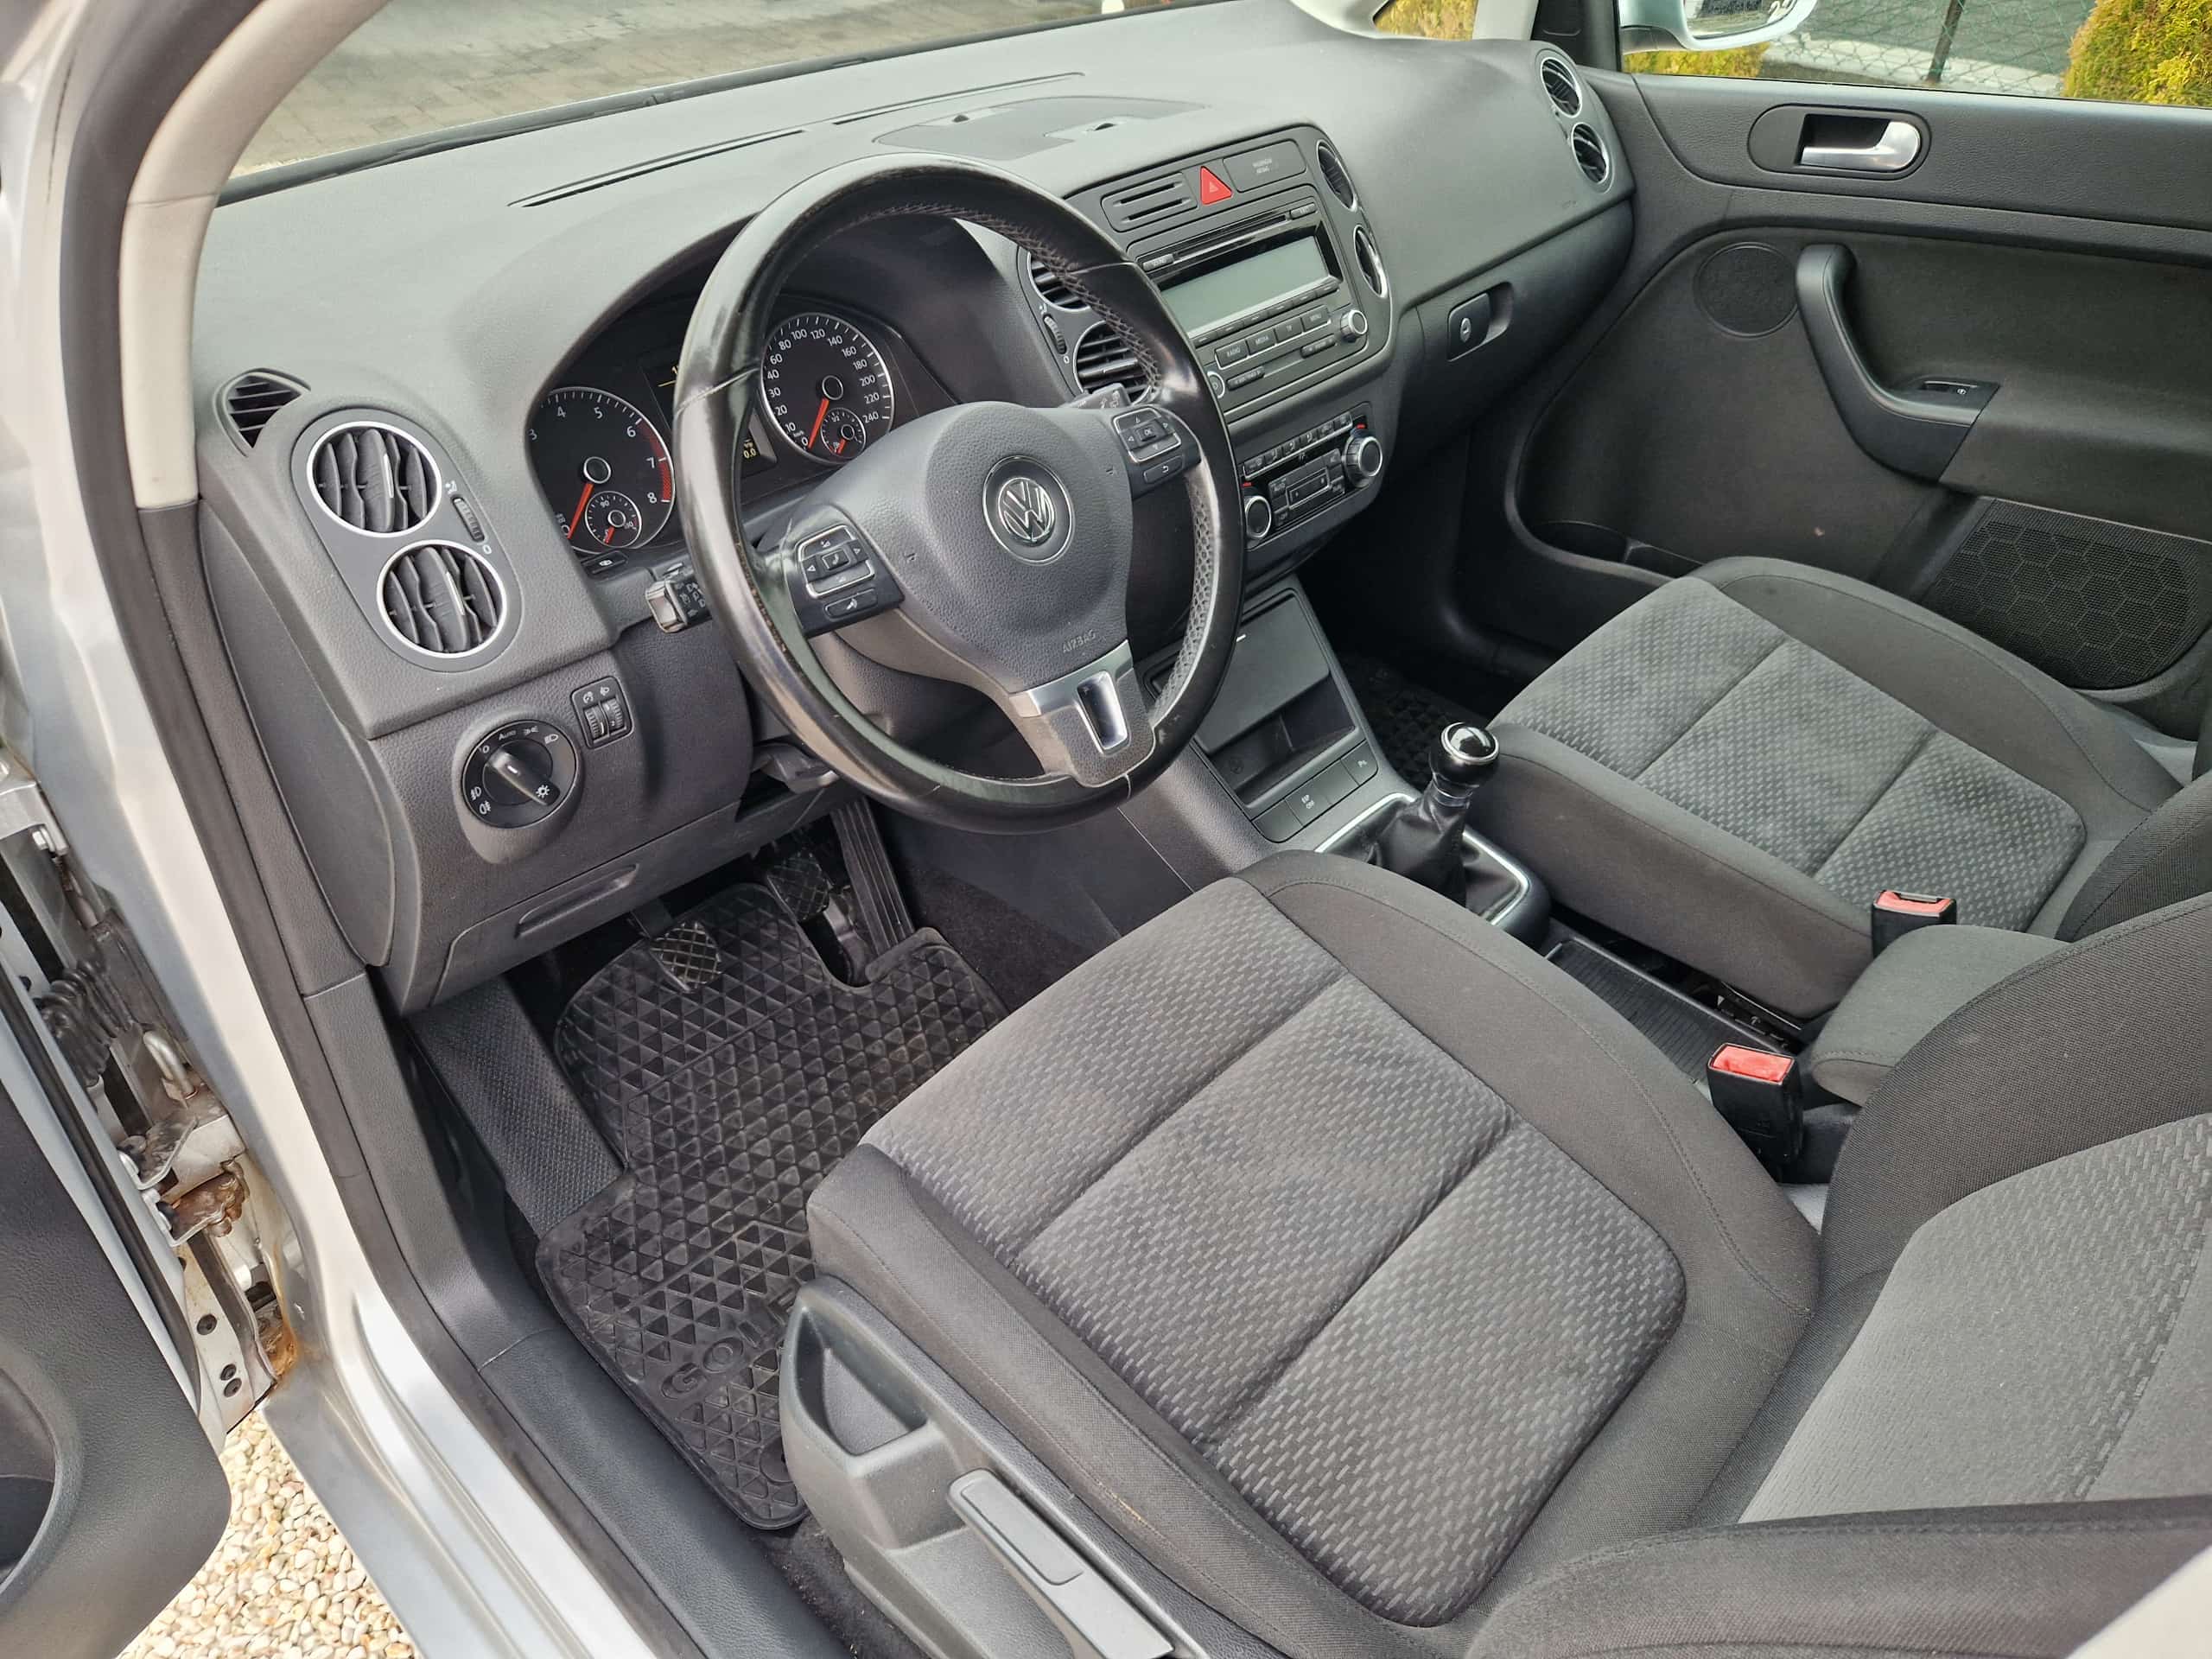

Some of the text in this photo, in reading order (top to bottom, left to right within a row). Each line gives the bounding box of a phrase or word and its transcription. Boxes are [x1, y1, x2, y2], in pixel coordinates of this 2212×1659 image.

[791, 328, 808, 341] 100
[810, 328, 826, 340] 120
[779, 340, 791, 351] 80
[827, 335, 843, 346] 140
[842, 346, 857, 358] 160
[770, 353, 783, 365] 60
[853, 359, 868, 370] 180
[767, 369, 779, 380] 40
[860, 375, 875, 386] 200
[769, 388, 781, 397] 30
[864, 393, 879, 404] 220
[556, 406, 566, 418] 4
[594, 407, 603, 419] 5
[776, 404, 788, 416] 20
[863, 411, 879, 423] 240
[626, 426, 636, 438] 6
[785, 423, 796, 432] 10
[528, 429, 537, 441] 3
[801, 436, 808, 447] 0
[646, 456, 655, 468] 7
[647, 492, 658, 504] 8
